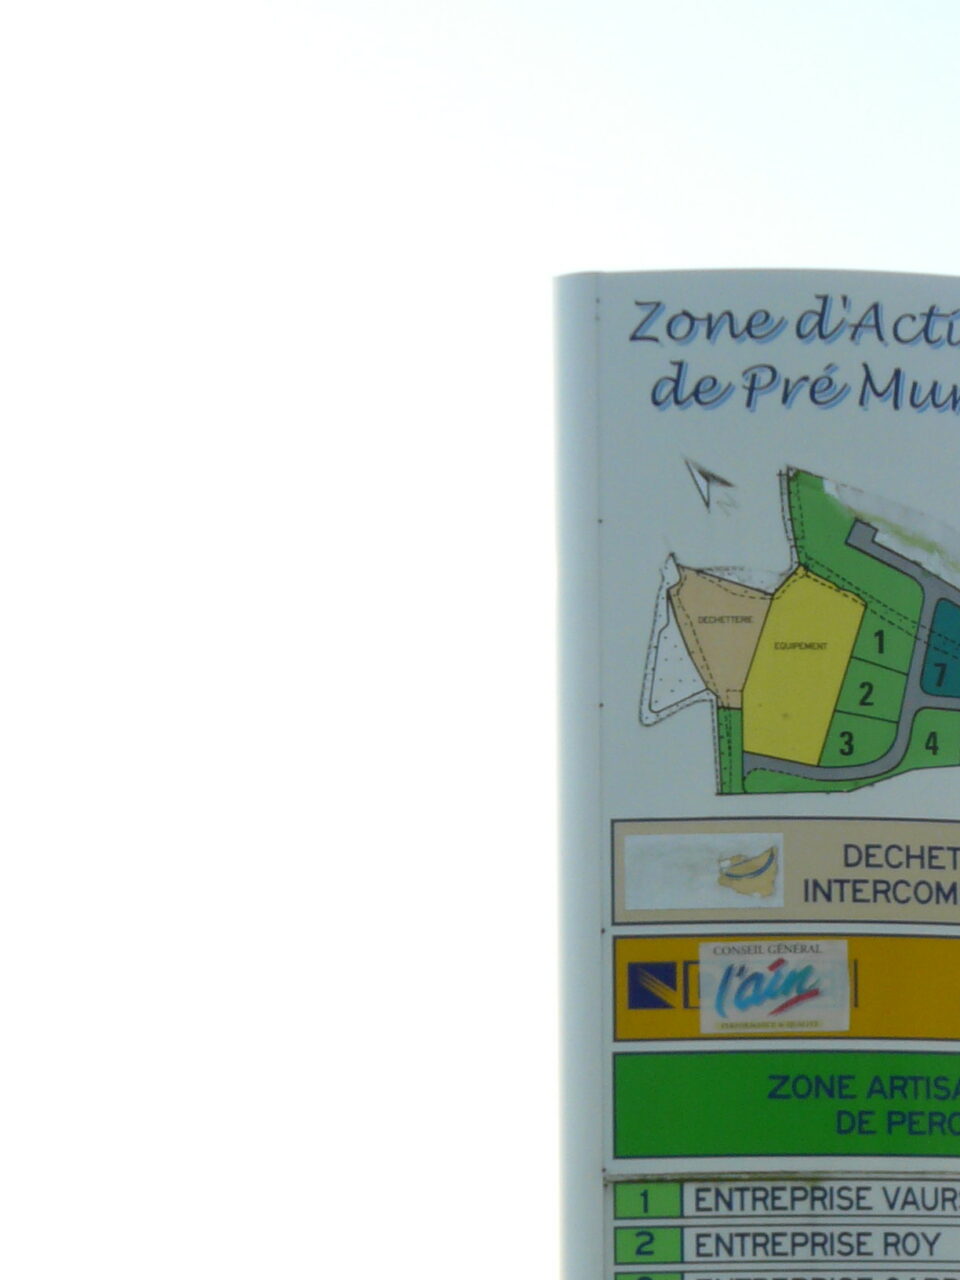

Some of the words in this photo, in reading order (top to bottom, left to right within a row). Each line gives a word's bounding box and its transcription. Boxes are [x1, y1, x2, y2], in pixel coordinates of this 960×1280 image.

[629, 299, 790, 347] Zone
[650, 360, 736, 410] de
[742, 361, 851, 411] Pré
[874, 630, 885, 654] 1
[934, 663, 947, 686] 7
[859, 681, 874, 707] 2
[839, 731, 855, 756] 3
[925, 730, 939, 755] 4
[713, 945, 764, 956] CONSEIL
[767, 1074, 857, 1100] ZONE
[836, 1110, 878, 1135] DE
[641, 1189, 650, 1213] 1
[694, 1186, 873, 1212] ENTREPRISE
[635, 1231, 655, 1256] 2
[695, 1231, 873, 1258] ENTREPRISE
[883, 1232, 942, 1257] ROY
